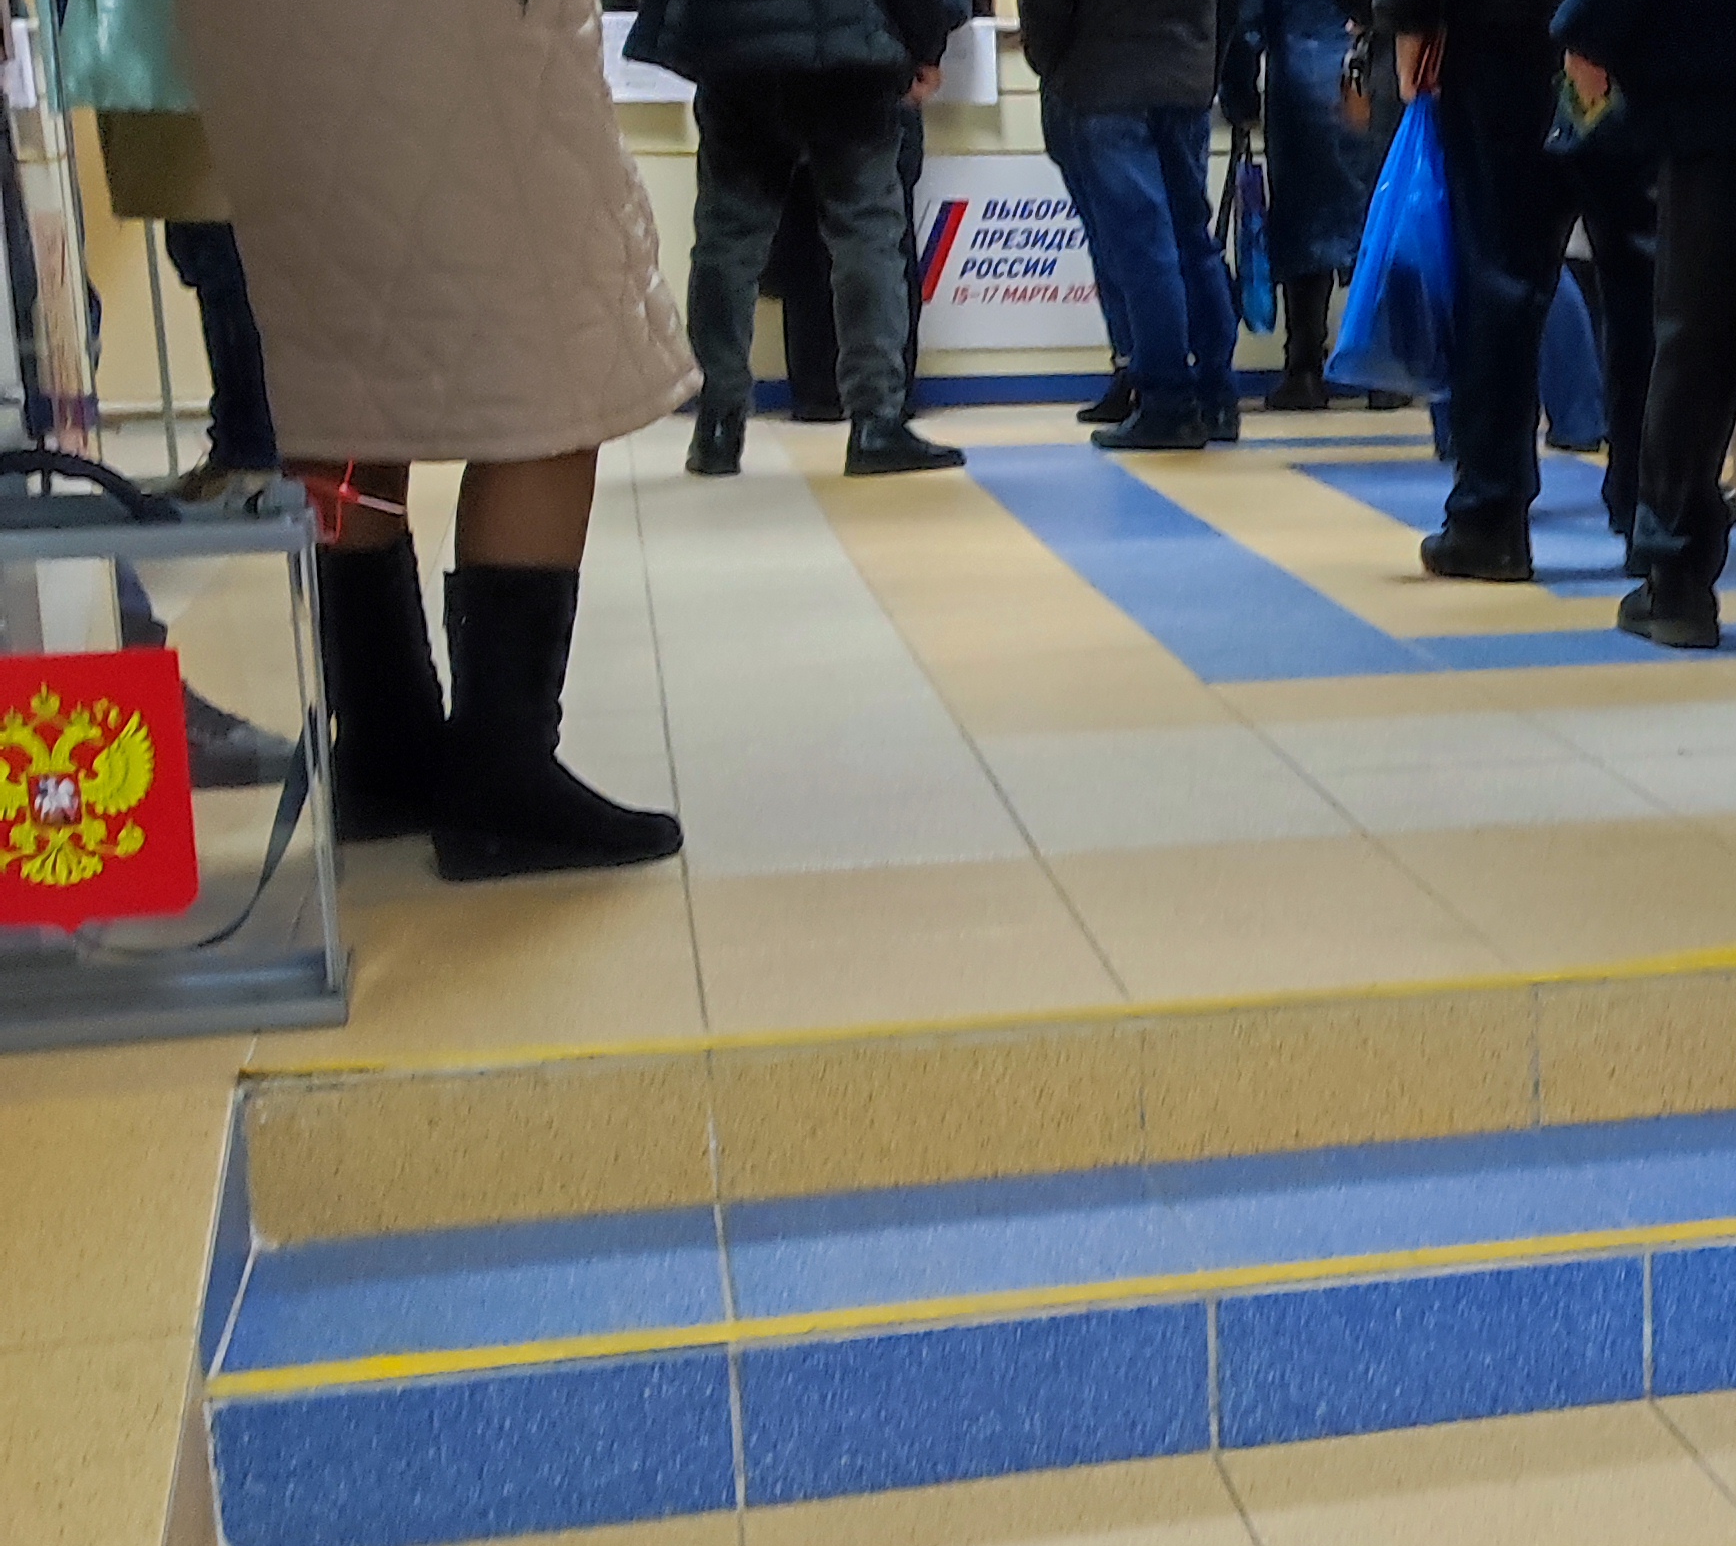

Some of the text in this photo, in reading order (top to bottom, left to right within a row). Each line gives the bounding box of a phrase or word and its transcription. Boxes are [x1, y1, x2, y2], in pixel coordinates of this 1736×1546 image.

[958, 256, 1058, 280] РОССИИ
[1001, 285, 1060, 304] МАРТА
[1061, 284, 1098, 304] 202
